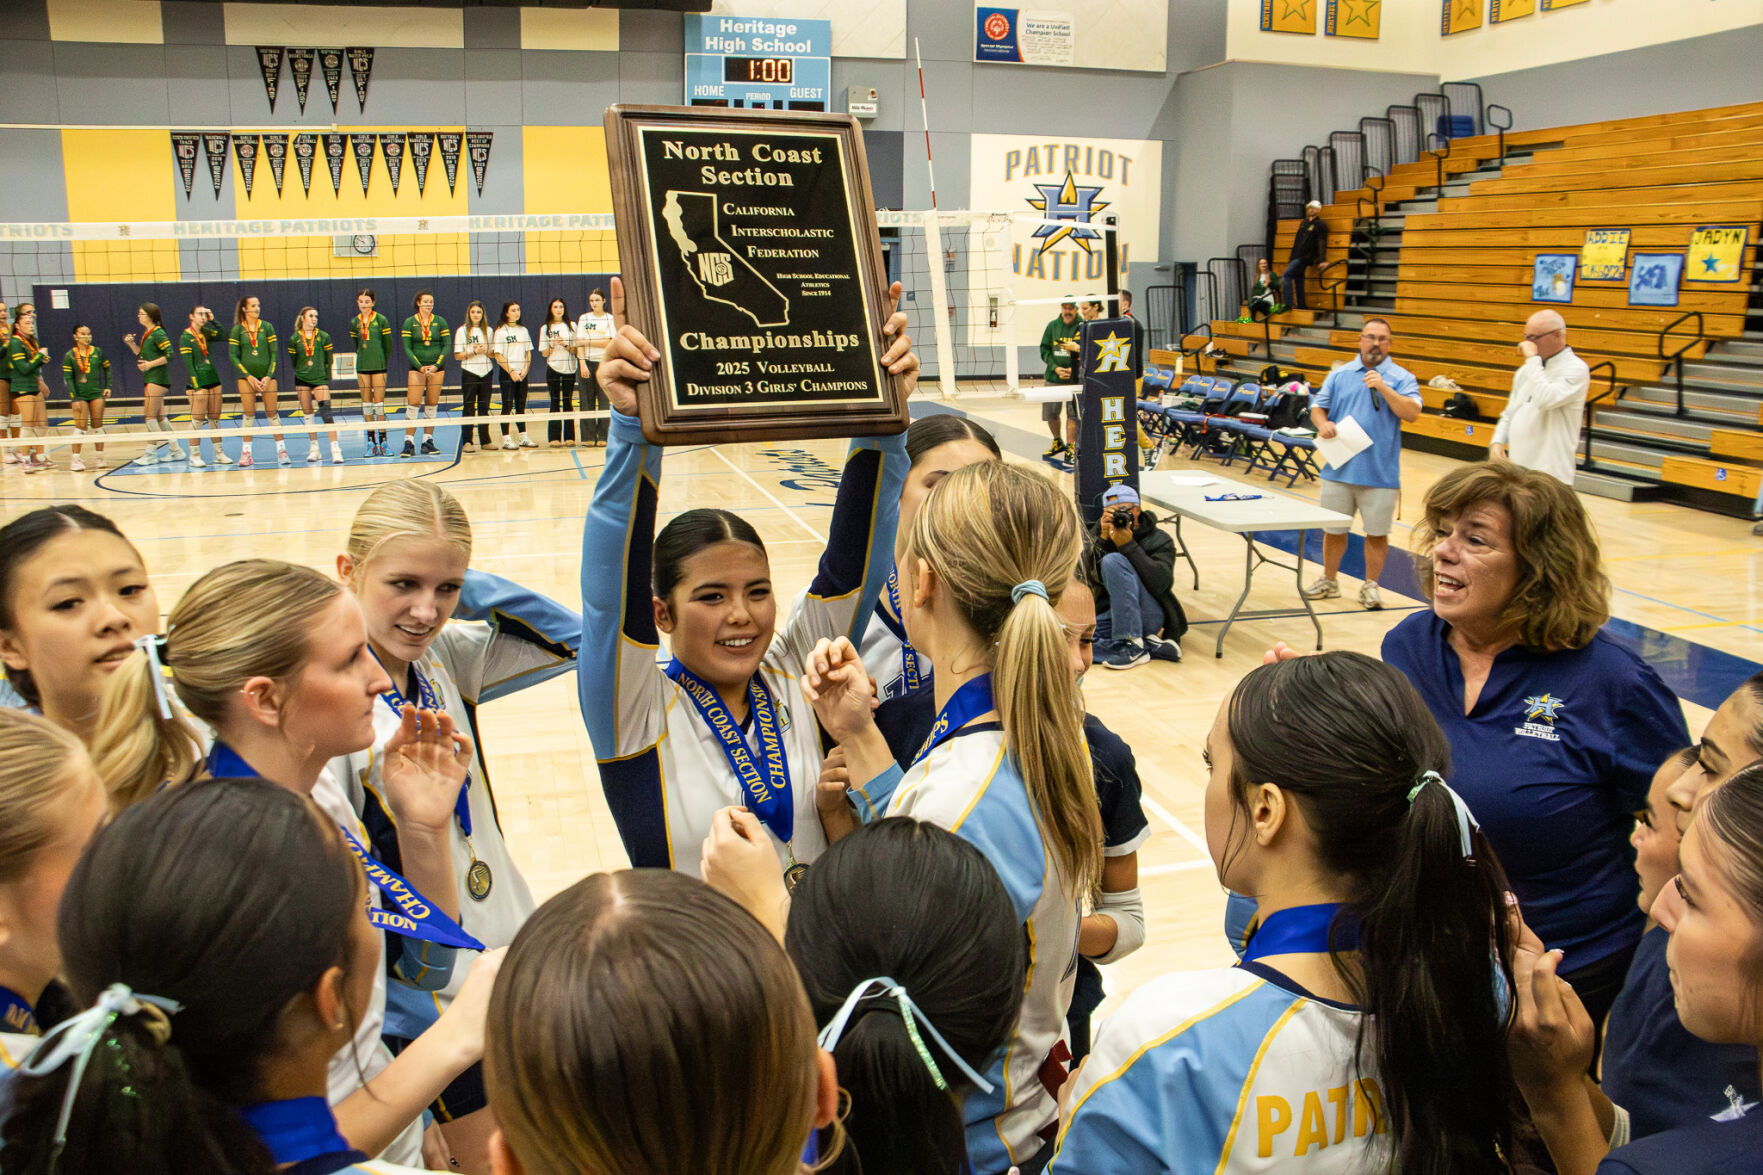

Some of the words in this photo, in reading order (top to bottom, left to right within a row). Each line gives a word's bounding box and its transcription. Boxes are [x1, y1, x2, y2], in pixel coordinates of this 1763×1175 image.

[720, 19, 797, 37] Heritage
[705, 36, 746, 53] High
[751, 38, 812, 53] School
[749, 59, 791, 82] 1:00
[694, 85, 724, 97] HOME
[789, 87, 823, 99] GUEST
[745, 92, 771, 100] PERIOD
[662, 140, 740, 161] North
[751, 143, 823, 164] Coast
[1004, 143, 1133, 187] PATRIOT
[701, 166, 794, 187] Section
[723, 202, 796, 217] CALIFORNIA
[173, 220, 275, 235] HERITAGE
[280, 218, 378, 233] PATRIOTS
[468, 215, 563, 229] HERITAGE
[731, 224, 835, 238] INTERSCHOLASTIC
[1588, 230, 1630, 244] ADDIE
[1694, 229, 1742, 245] JADYN
[747, 245, 820, 258] FEDERATION
[697, 252, 735, 287] NCS
[506, 335, 517, 344] SM
[679, 330, 860, 354] Championships
[716, 361, 750, 376] 2025
[757, 360, 835, 374] VOLLEYBALL
[686, 382, 742, 396] DIVISION
[744, 380, 754, 394] 3
[800, 379, 868, 393] CHAMPIONS
[1101, 396, 1130, 486] HER
[679, 672, 716, 708] NORTH
[707, 706, 742, 747] COAST
[730, 746, 773, 804] SECTION
